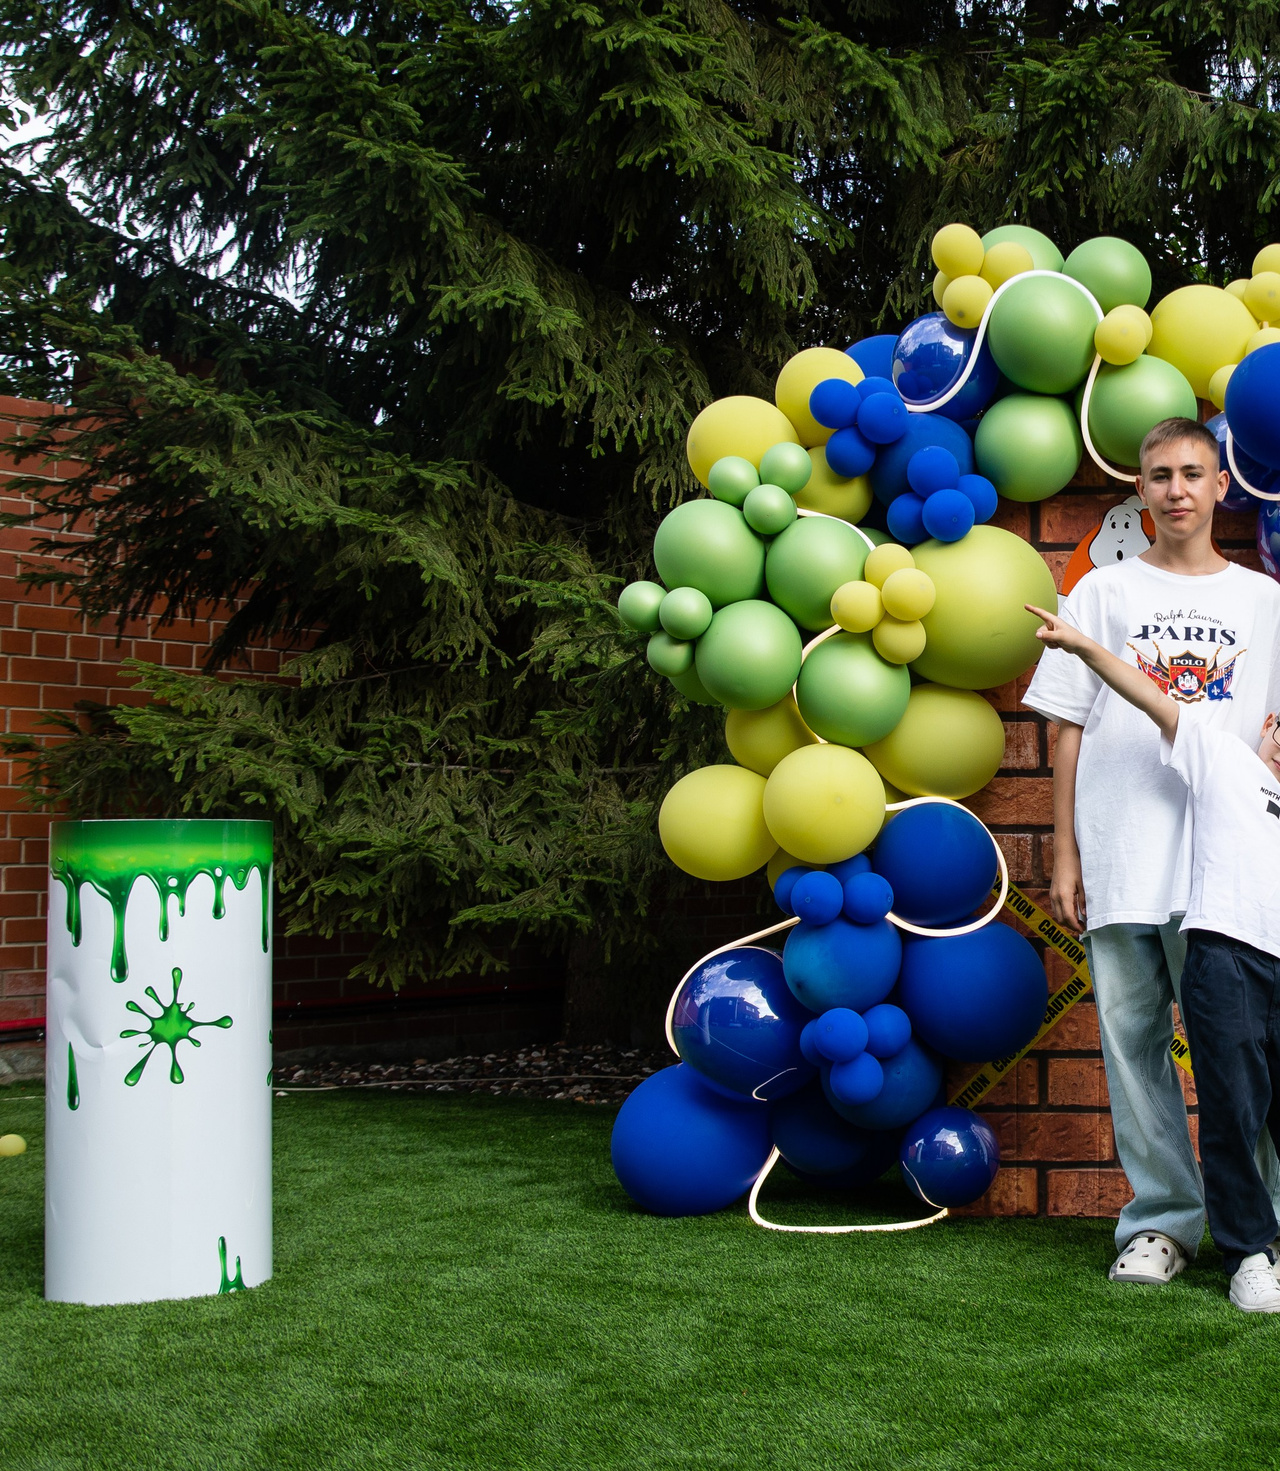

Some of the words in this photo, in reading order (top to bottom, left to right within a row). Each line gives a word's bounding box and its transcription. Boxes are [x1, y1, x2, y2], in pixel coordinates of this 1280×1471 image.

[1154, 609, 1185, 623] Ralph
[1187, 609, 1224, 626] Lauren
[1128, 624, 1236, 646] PARIS
[1173, 658, 1204, 666] POLO
[1260, 787, 1280, 800] NORTH
[1037, 919, 1087, 966] CAUTION
[1043, 976, 1087, 1025] CAUTION
